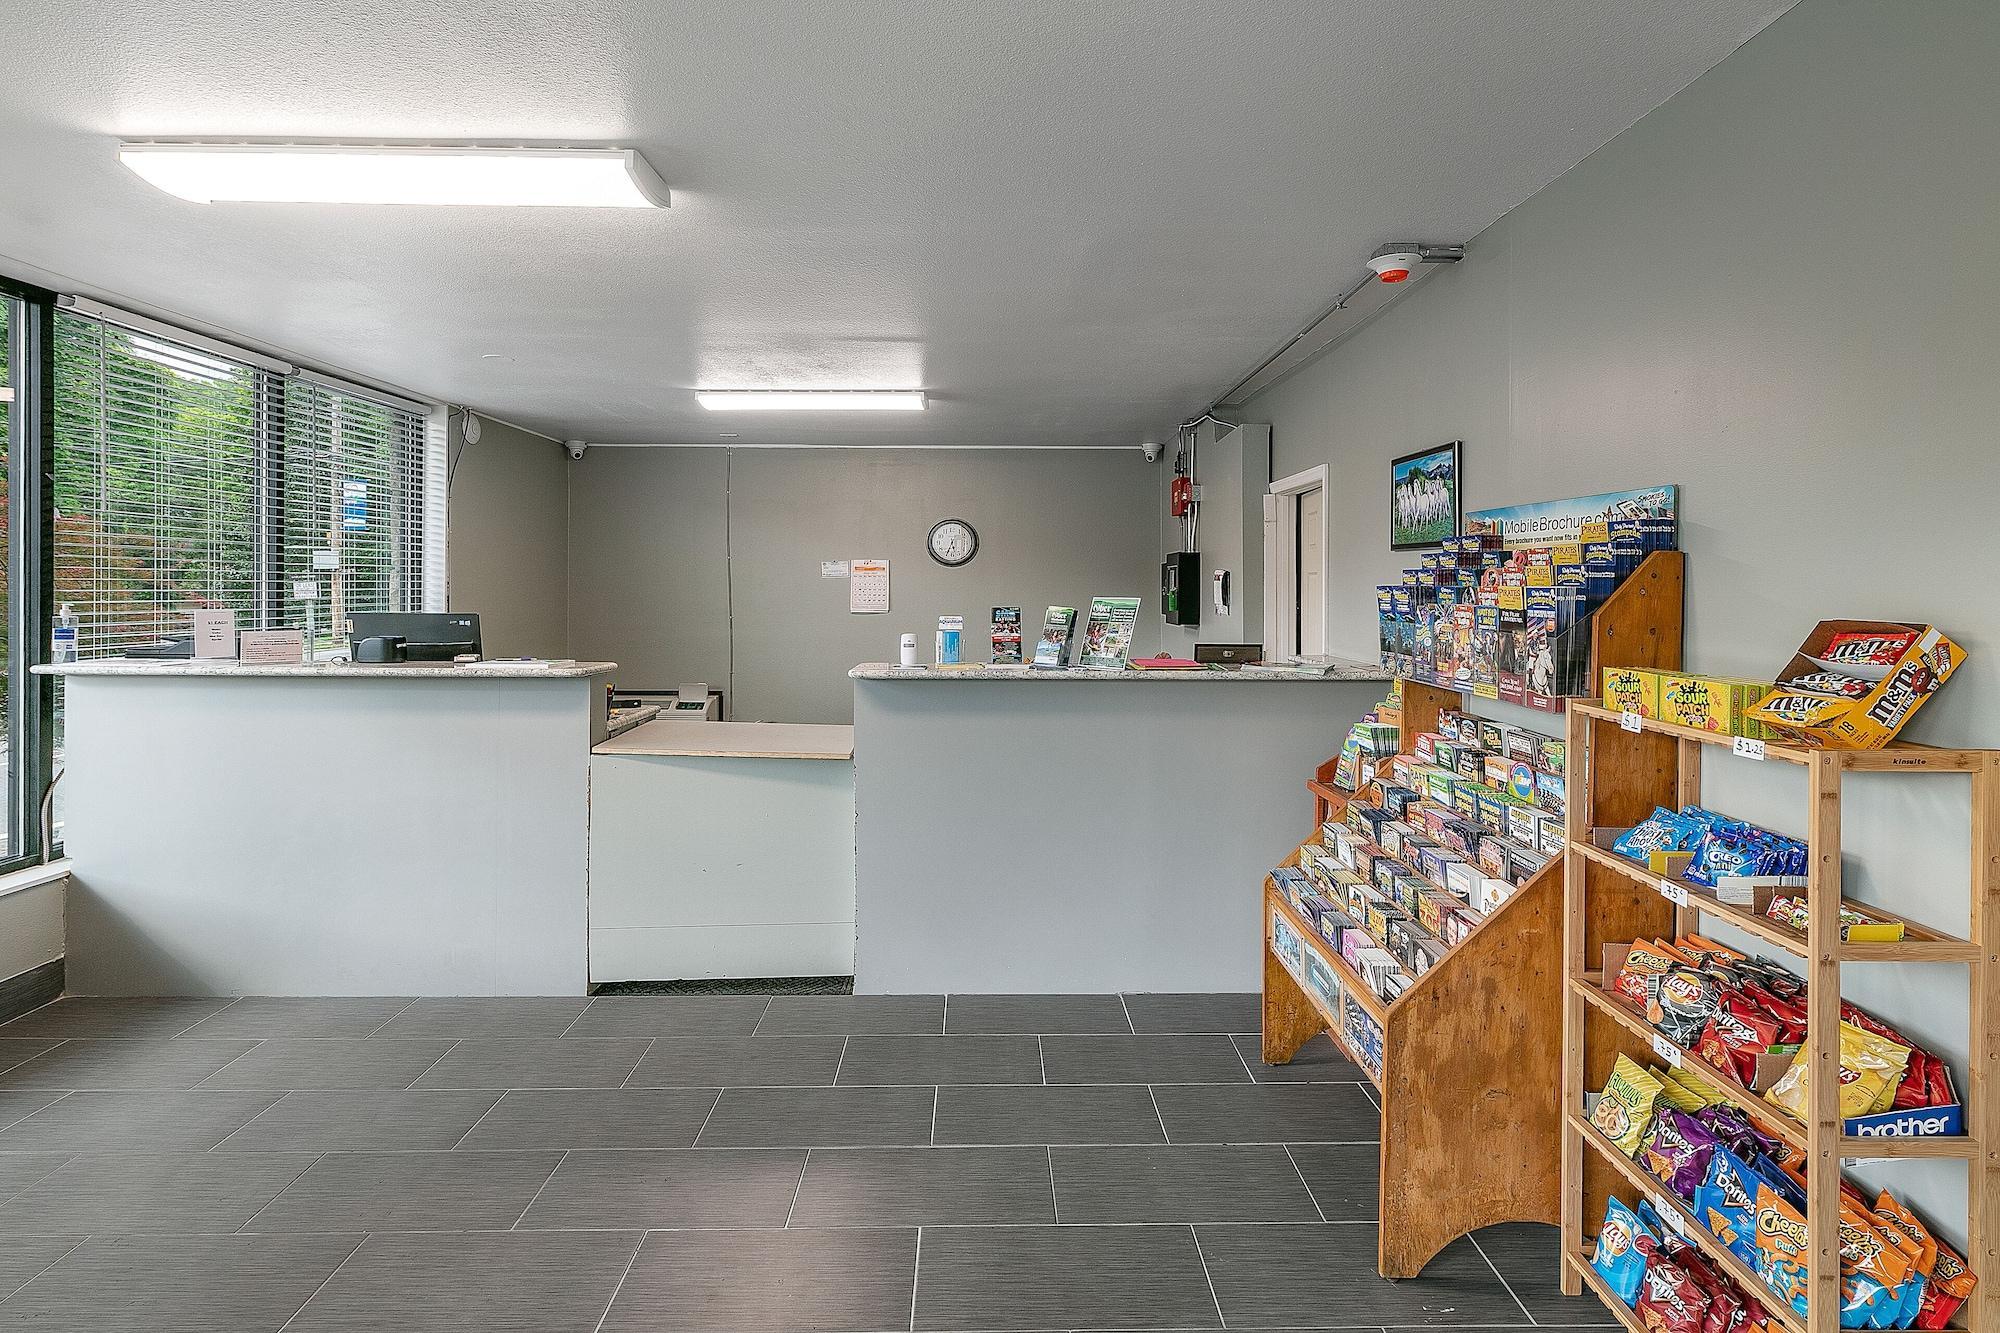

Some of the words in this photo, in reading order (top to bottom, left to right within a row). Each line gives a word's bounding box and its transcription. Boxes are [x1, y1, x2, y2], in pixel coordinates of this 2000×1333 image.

[1581, 524, 1607, 535] PIRATES
[1553, 546, 1577, 556] PIRATES
[1527, 567, 1550, 577] PIRATES
[1615, 681, 1641, 693] SOUR
[1615, 691, 1642, 704] PATCH
[1676, 692, 1708, 705] SOUR
[1676, 703, 1710, 717] PATCH
[1623, 713, 1639, 730] $1
[1838, 720, 1855, 735] 18
[1709, 850, 1745, 866] OREO
[1857, 1116, 1950, 1136] brother
[1658, 1119, 1696, 1154] Doritos
[1715, 1173, 1757, 1216] Doritos
[1645, 1268, 1686, 1311] Doritos
